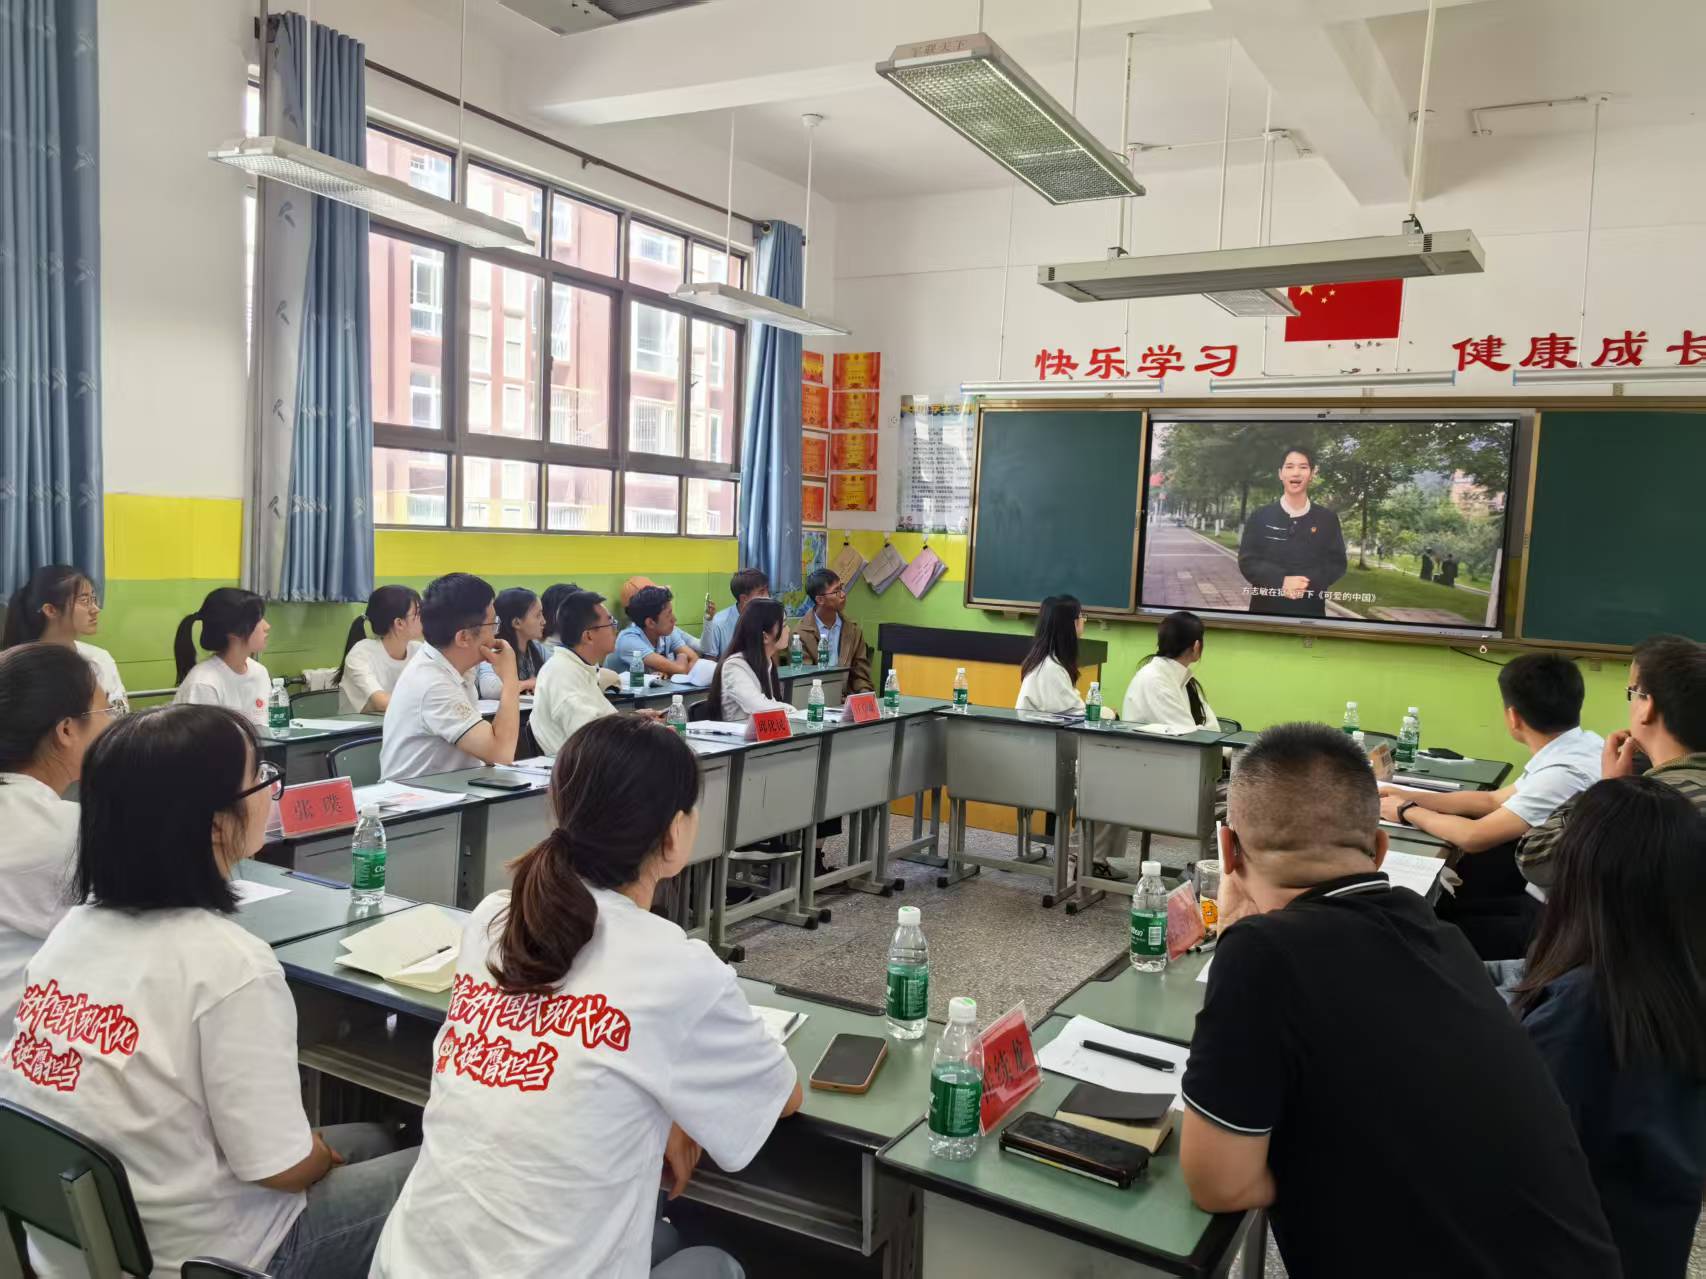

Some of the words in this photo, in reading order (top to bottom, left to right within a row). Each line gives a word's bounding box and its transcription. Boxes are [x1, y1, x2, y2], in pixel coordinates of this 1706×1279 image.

[1035, 345, 1239, 382] 快乐学习
[1453, 331, 1706, 373] 健康成长
